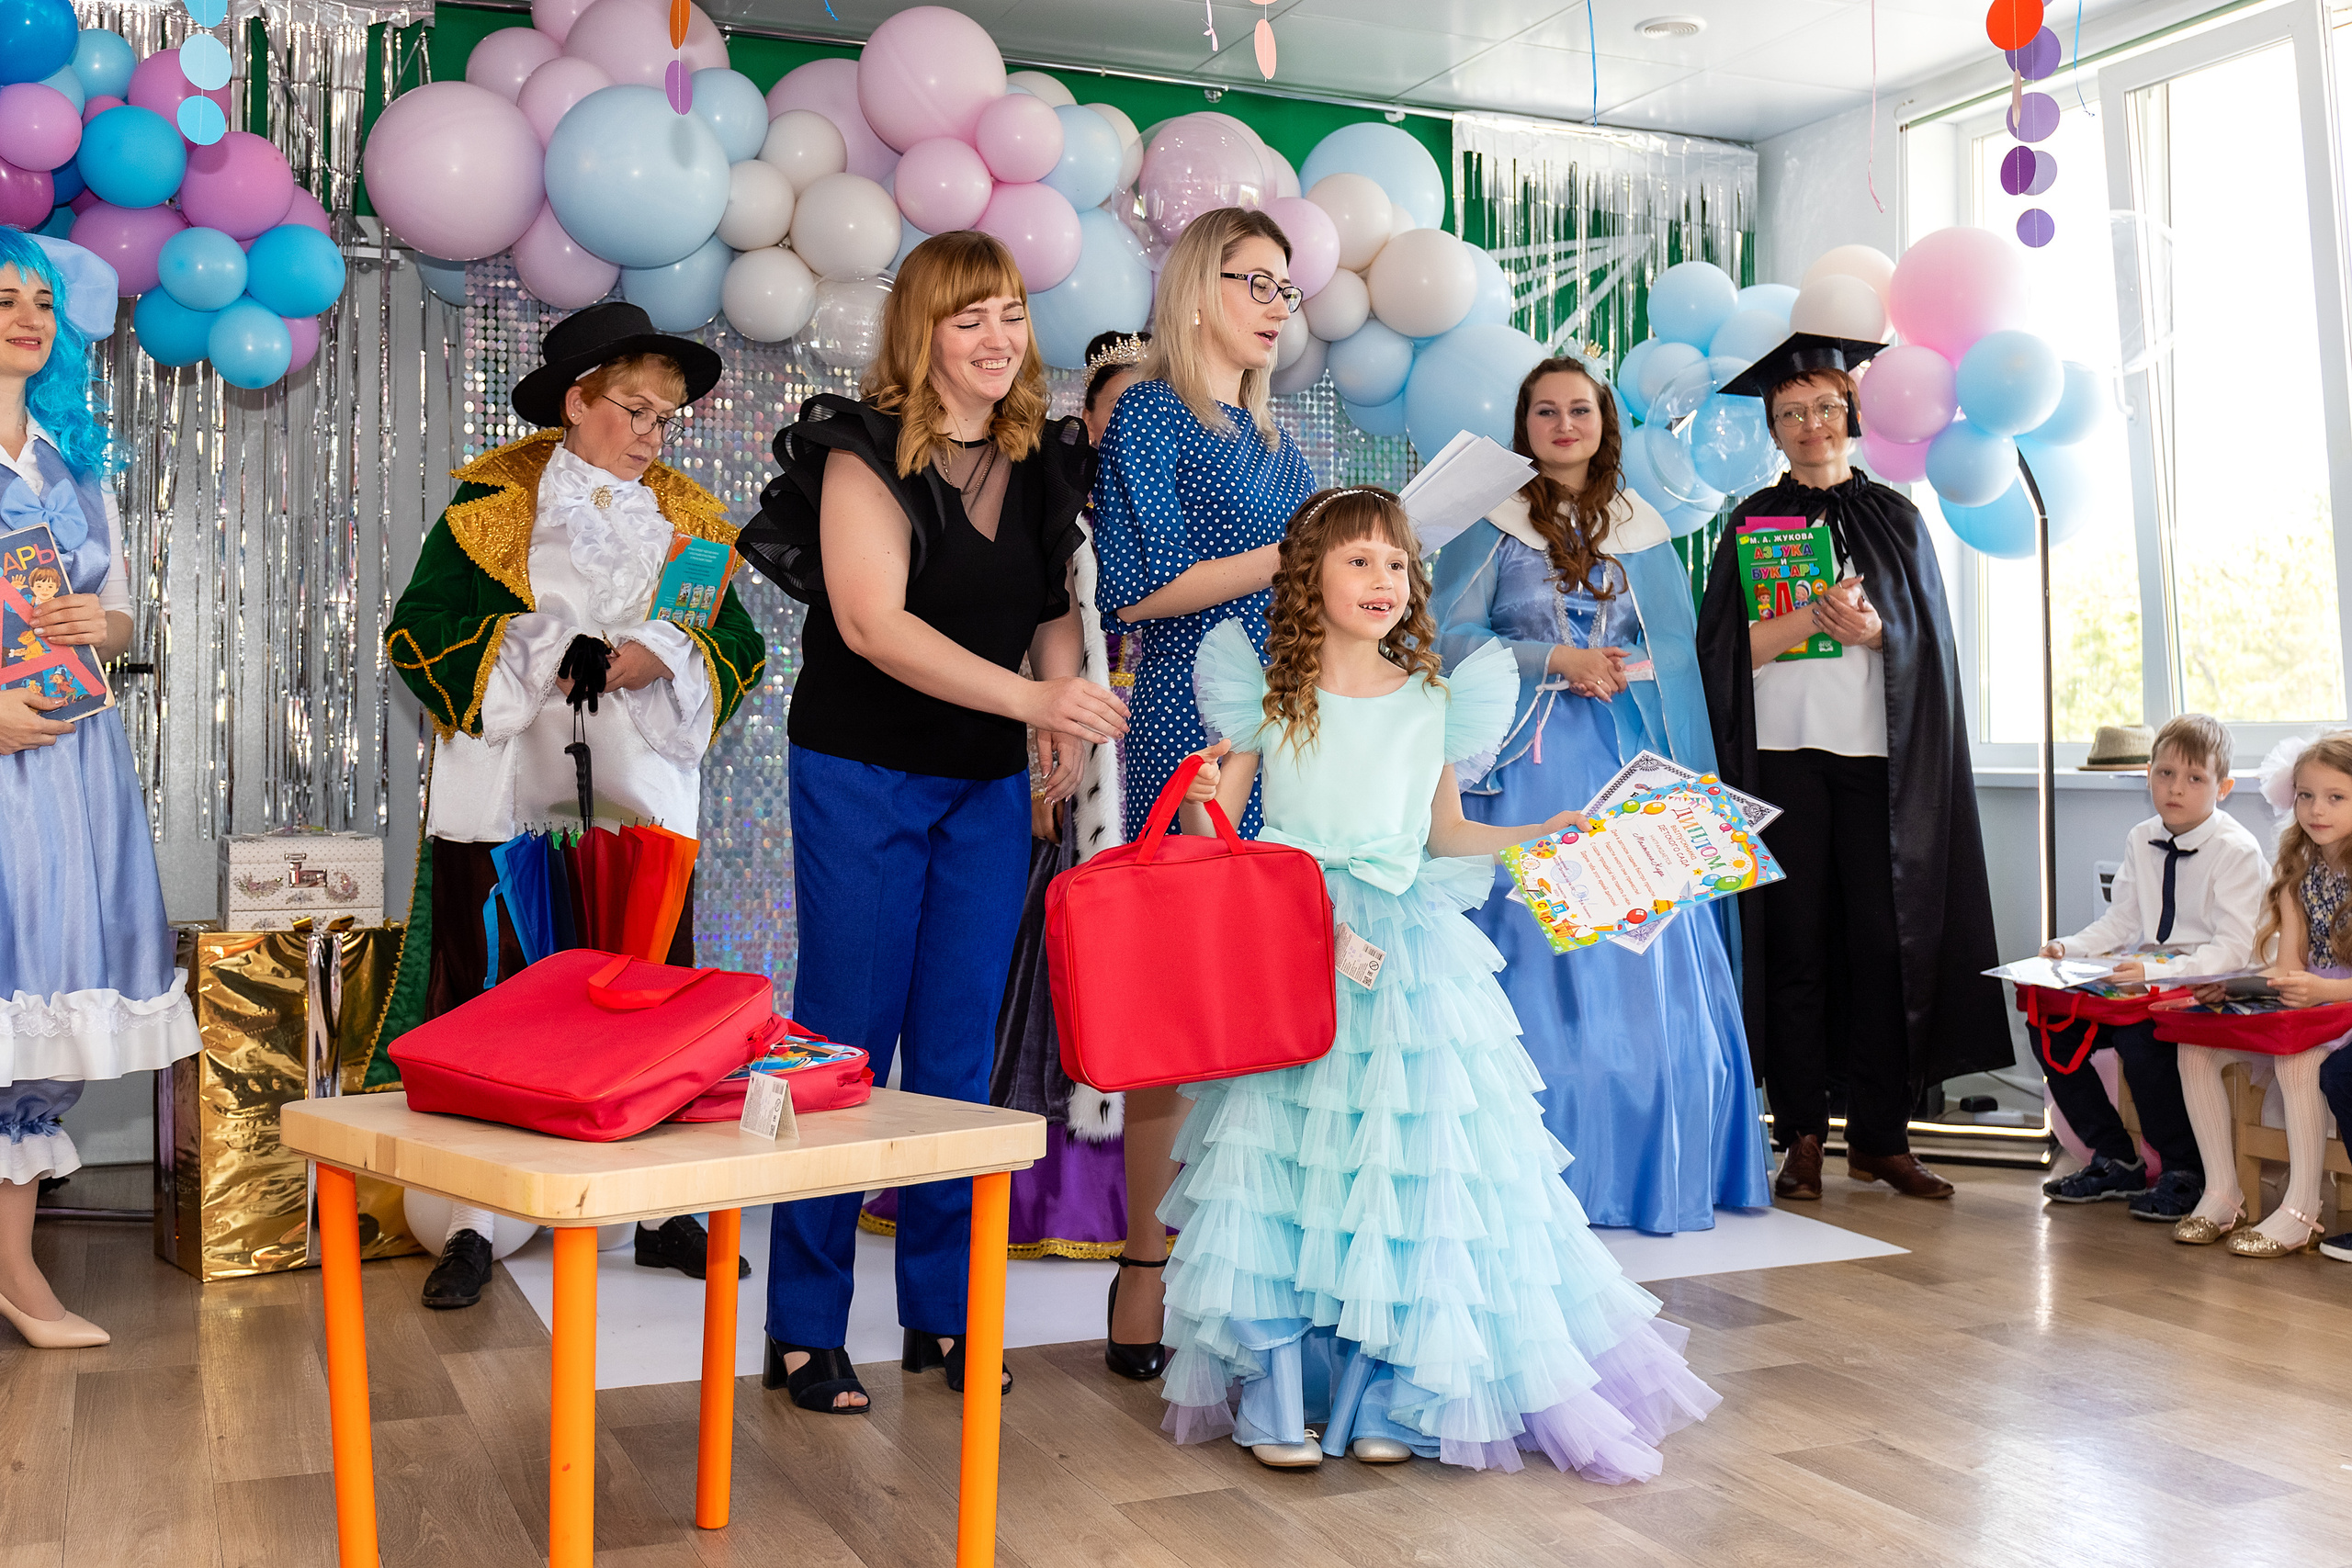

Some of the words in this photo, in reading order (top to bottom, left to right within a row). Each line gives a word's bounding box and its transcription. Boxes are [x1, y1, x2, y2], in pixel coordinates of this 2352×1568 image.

[1749, 536, 1760, 545] М.
[1762, 536, 1771, 544] А.
[1773, 532, 1815, 543] ЖУКОВА
[1754, 543, 1814, 559] АЗБУКА
[1751, 562, 1820, 581] БУКВАРЬ
[1650, 835, 1672, 865] НАГРАЖДАЕТСЯ
[1658, 824, 1680, 852] ДЕТСКОГО
[1676, 853, 1690, 867] САДА
[1671, 808, 1726, 869] ДИПЛОМ
[1671, 825, 1696, 860] выпускника
[1635, 867, 1646, 881] быстро
